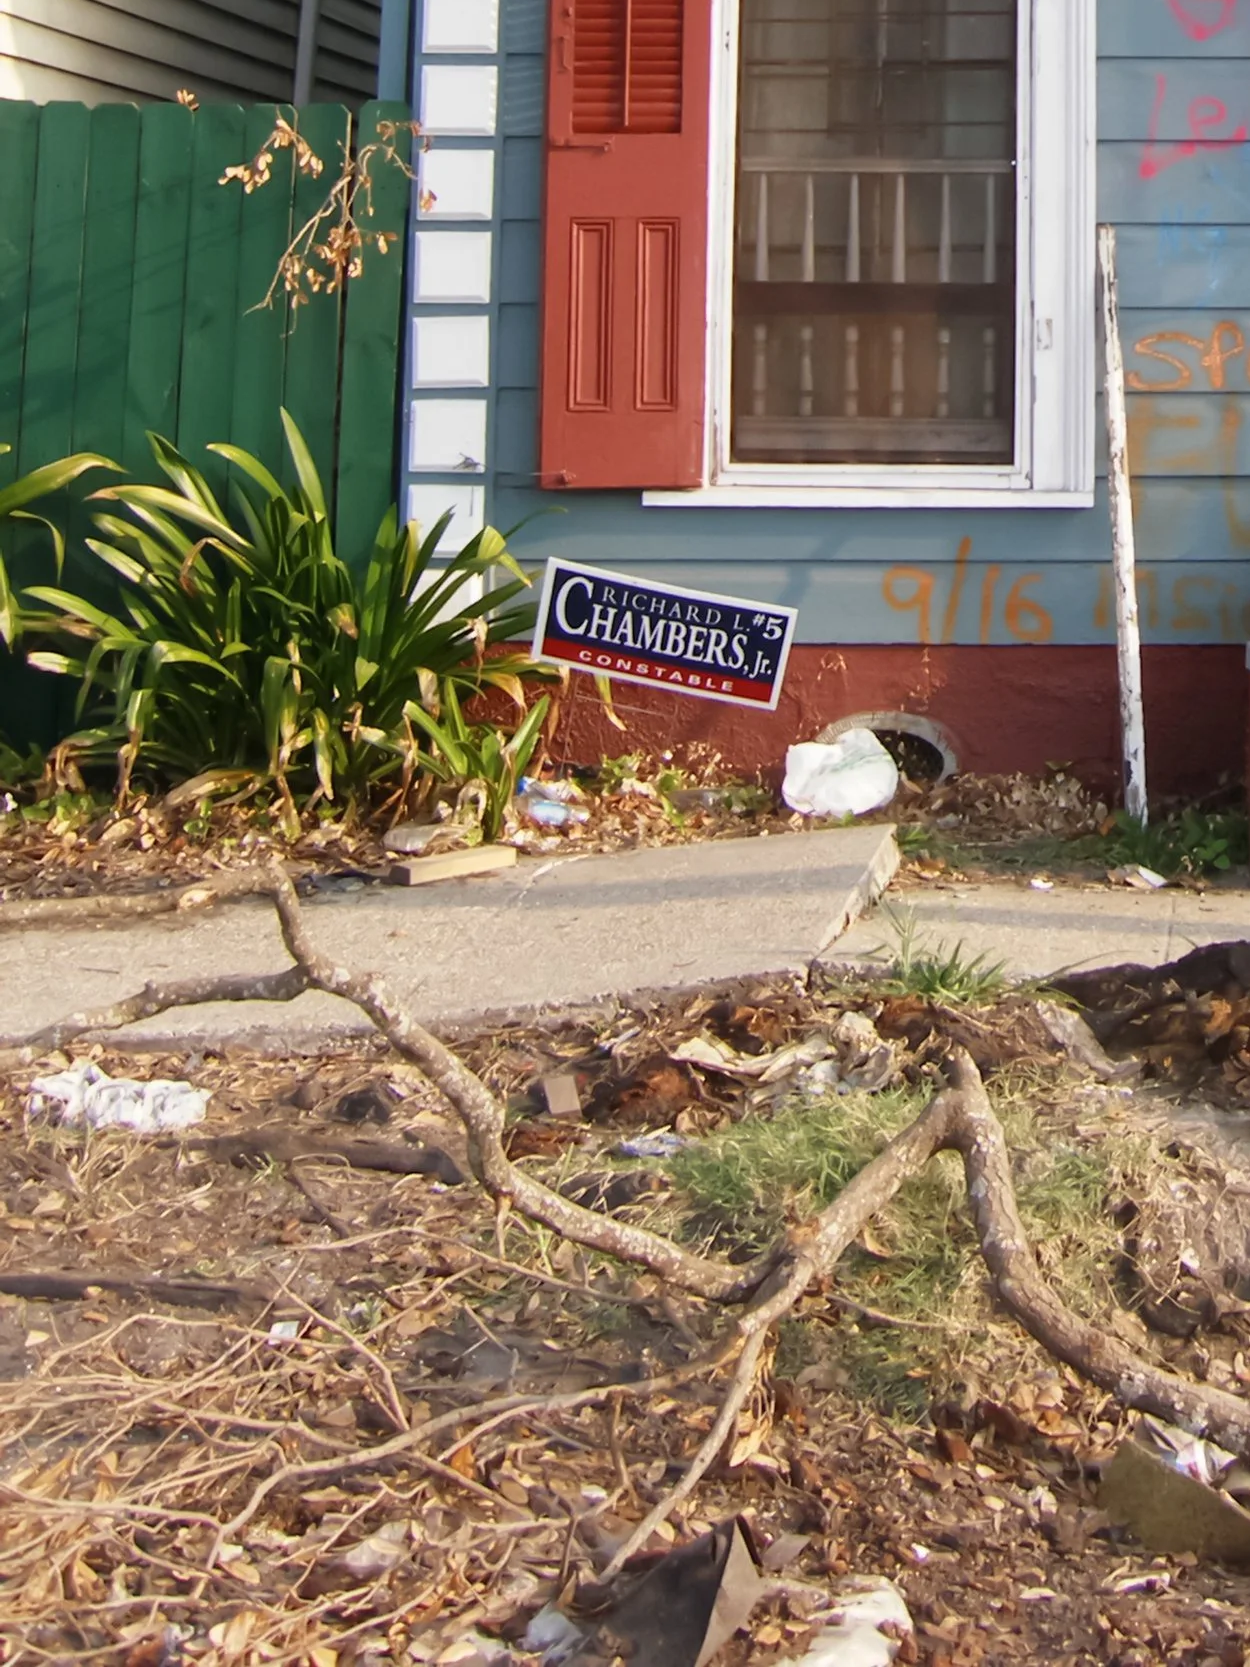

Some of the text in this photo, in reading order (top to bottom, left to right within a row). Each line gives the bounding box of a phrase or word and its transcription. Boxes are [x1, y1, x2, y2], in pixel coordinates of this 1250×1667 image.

[601, 586, 751, 632] RICHARD L.
[882, 536, 1053, 645] 9/16
[752, 613, 783, 640] #5
[579, 649, 734, 693] CONSTABLE
[748, 650, 773, 679] Jr.
